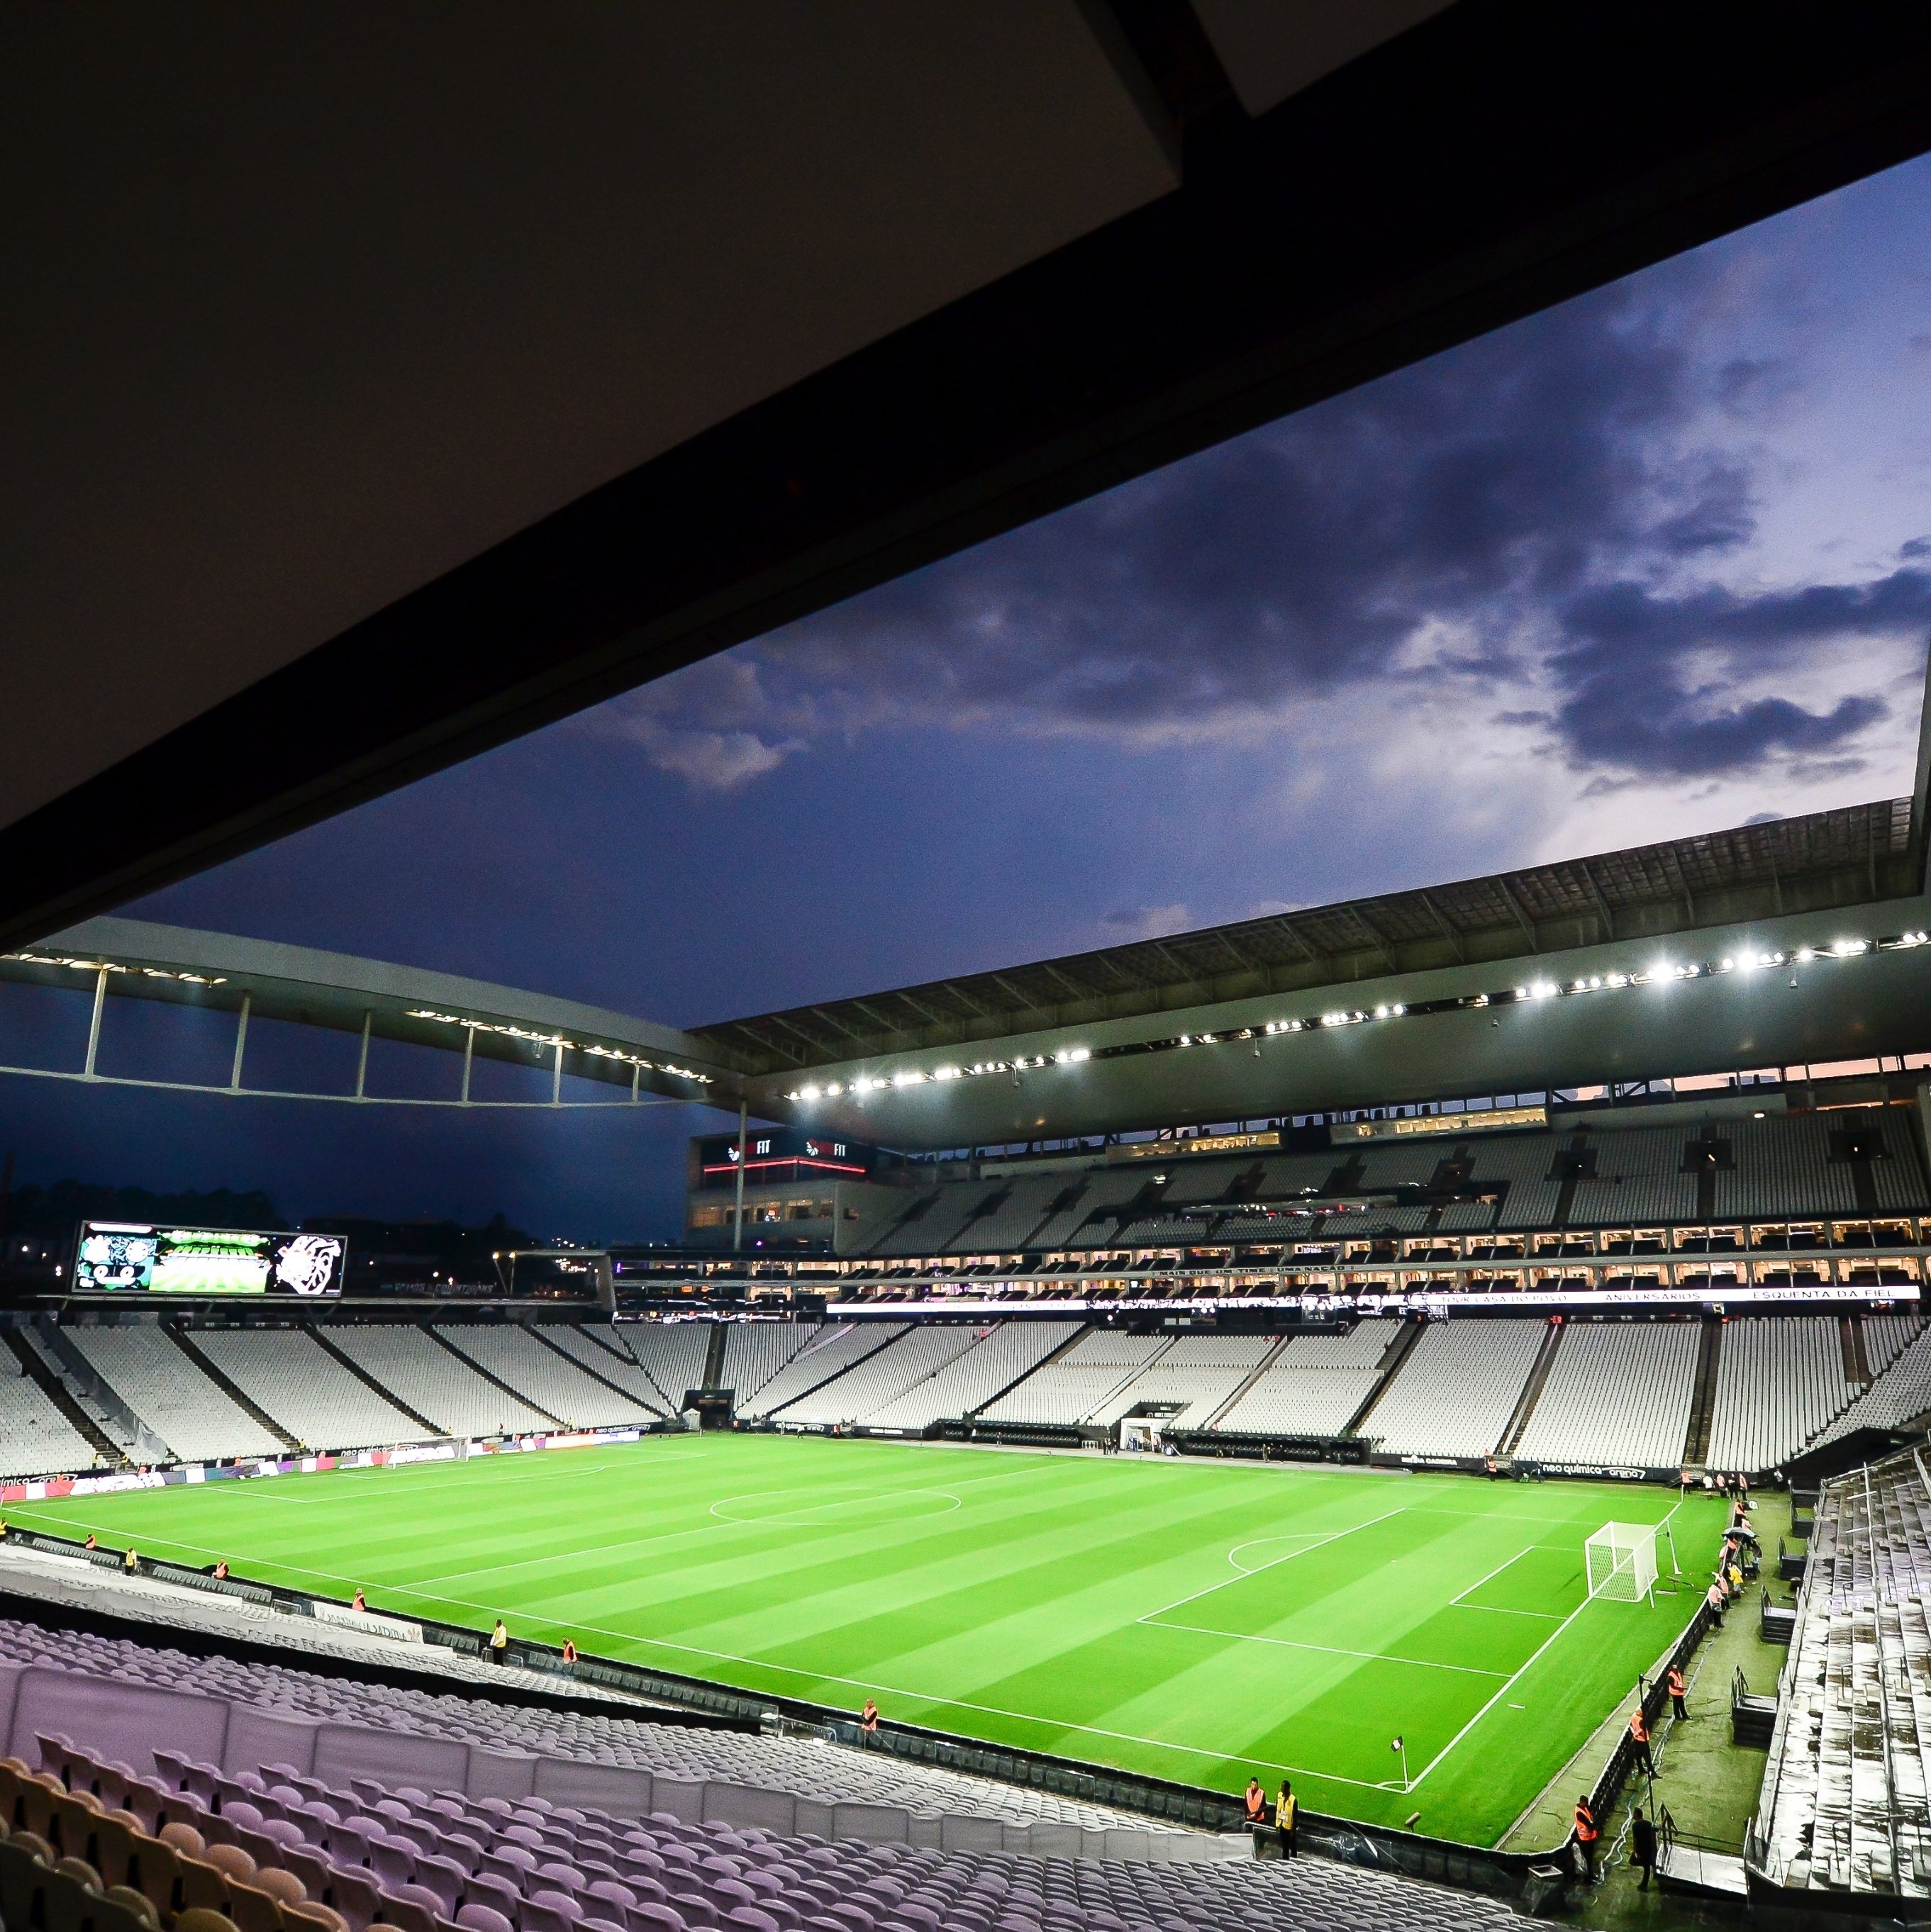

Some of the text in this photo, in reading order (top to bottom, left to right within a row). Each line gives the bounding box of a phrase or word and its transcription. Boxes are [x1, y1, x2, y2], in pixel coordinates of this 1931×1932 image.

[757, 1139, 771, 1154] FIT
[834, 1143, 846, 1156] FIT
[1754, 1290, 1830, 1299] ESQUENTA
[1542, 1464, 1562, 1473] neo
[1608, 1469, 1638, 1478] arena
